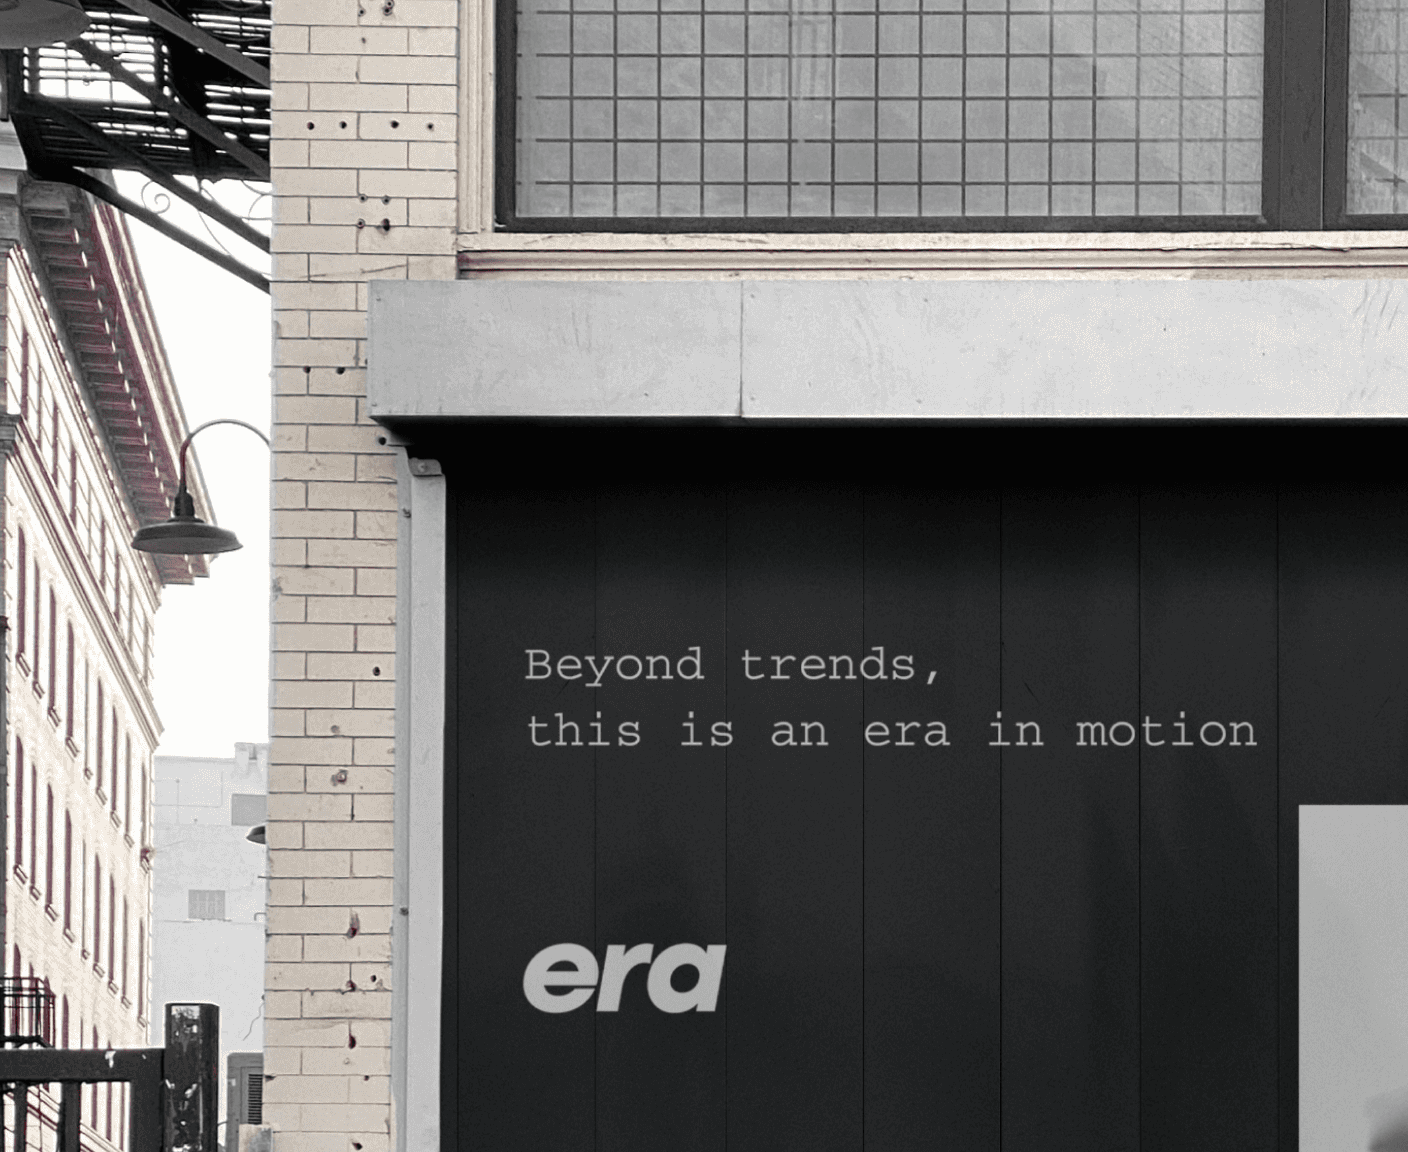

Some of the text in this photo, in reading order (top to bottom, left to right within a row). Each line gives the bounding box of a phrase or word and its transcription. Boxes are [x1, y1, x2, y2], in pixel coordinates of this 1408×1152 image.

[524, 645, 938, 688] Beyond trends,
[527, 710, 1258, 747] this is an era in motion
[522, 942, 728, 1014] era
